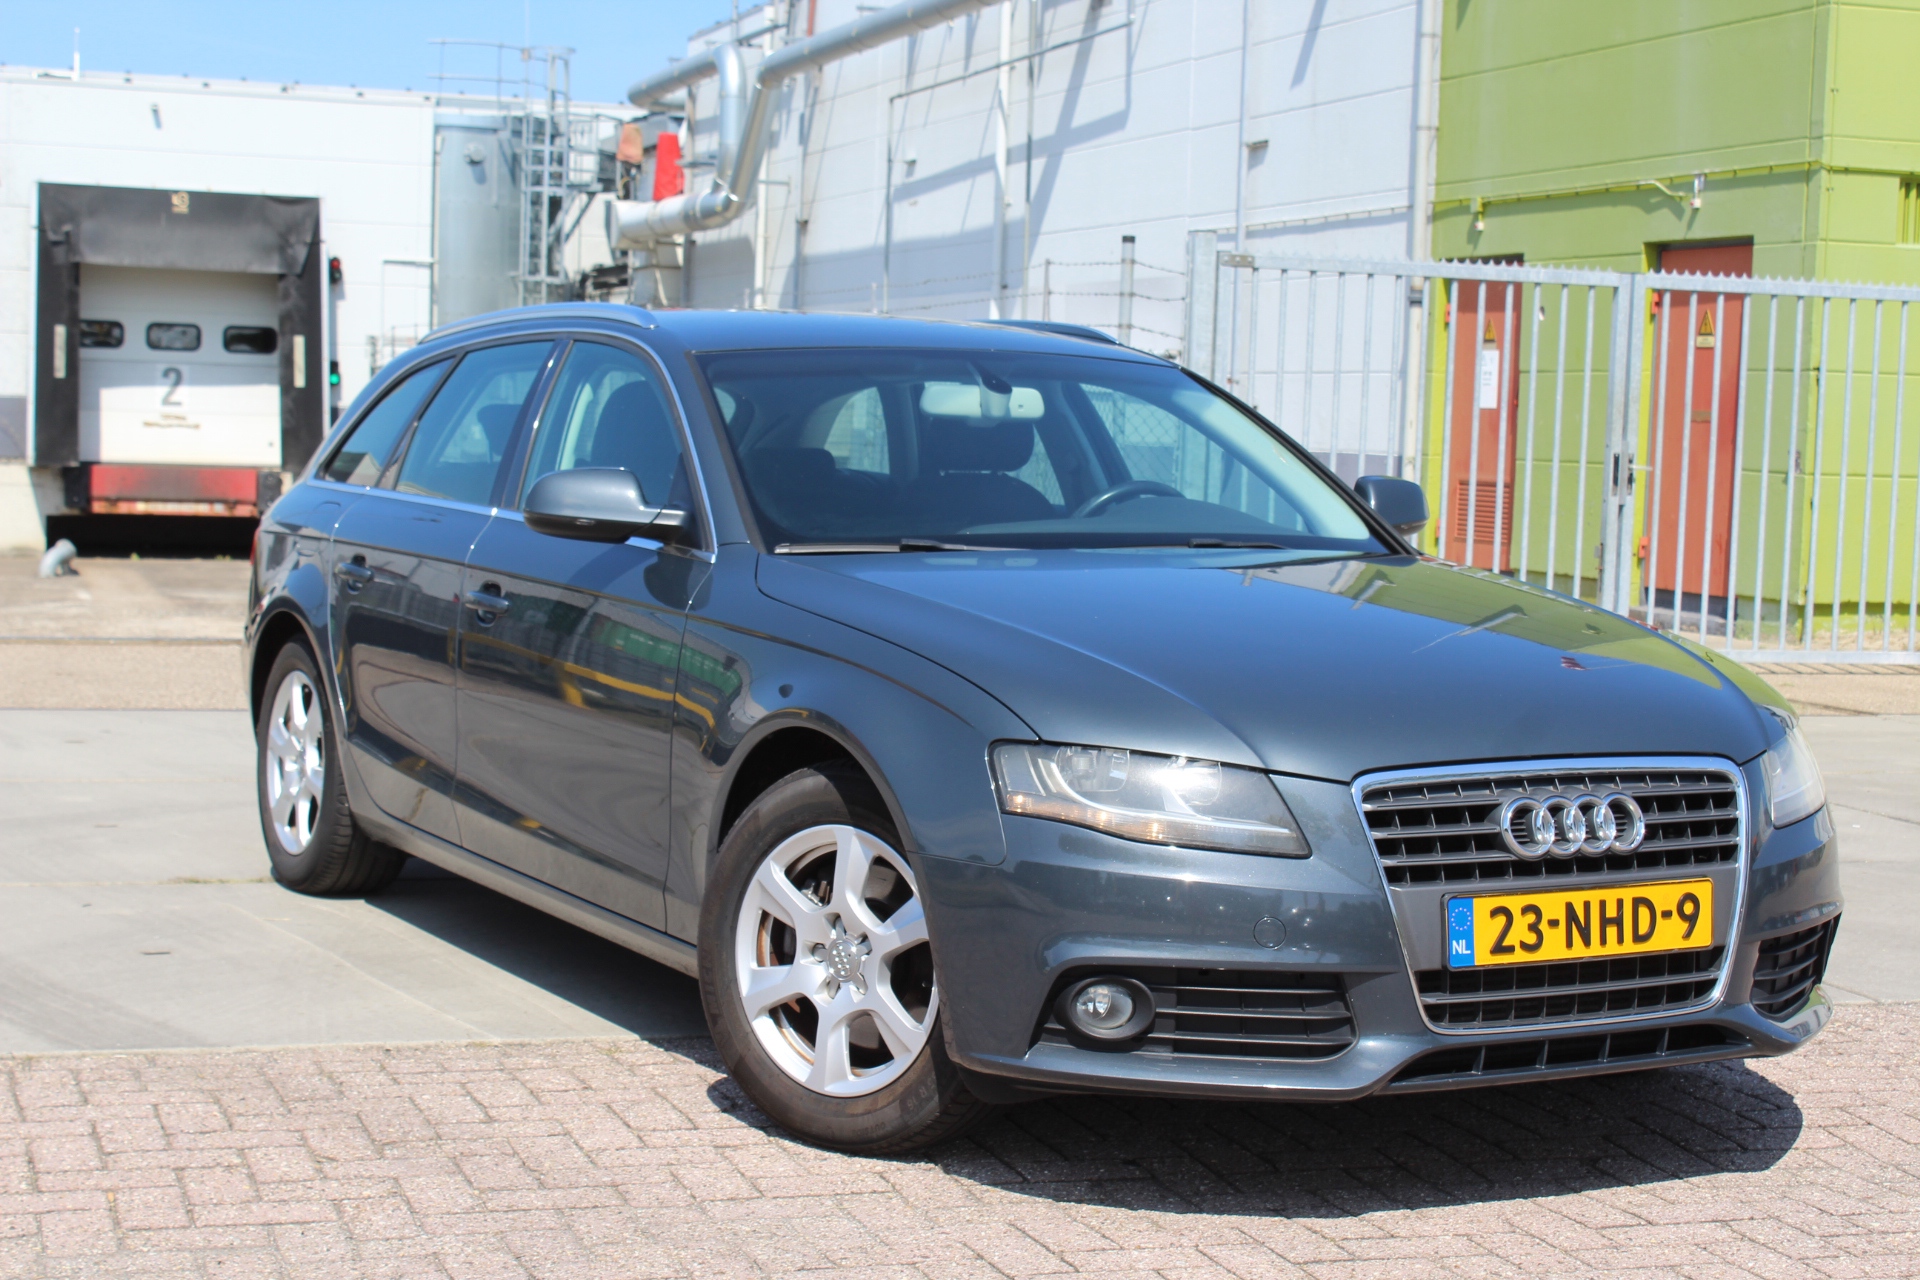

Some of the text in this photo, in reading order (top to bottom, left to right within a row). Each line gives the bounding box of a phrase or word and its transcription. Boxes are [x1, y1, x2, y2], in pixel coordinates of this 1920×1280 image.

[160, 366, 183, 406] 2
[1489, 892, 1701, 955] 23-NHD-9
[1452, 939, 1471, 955] NL
